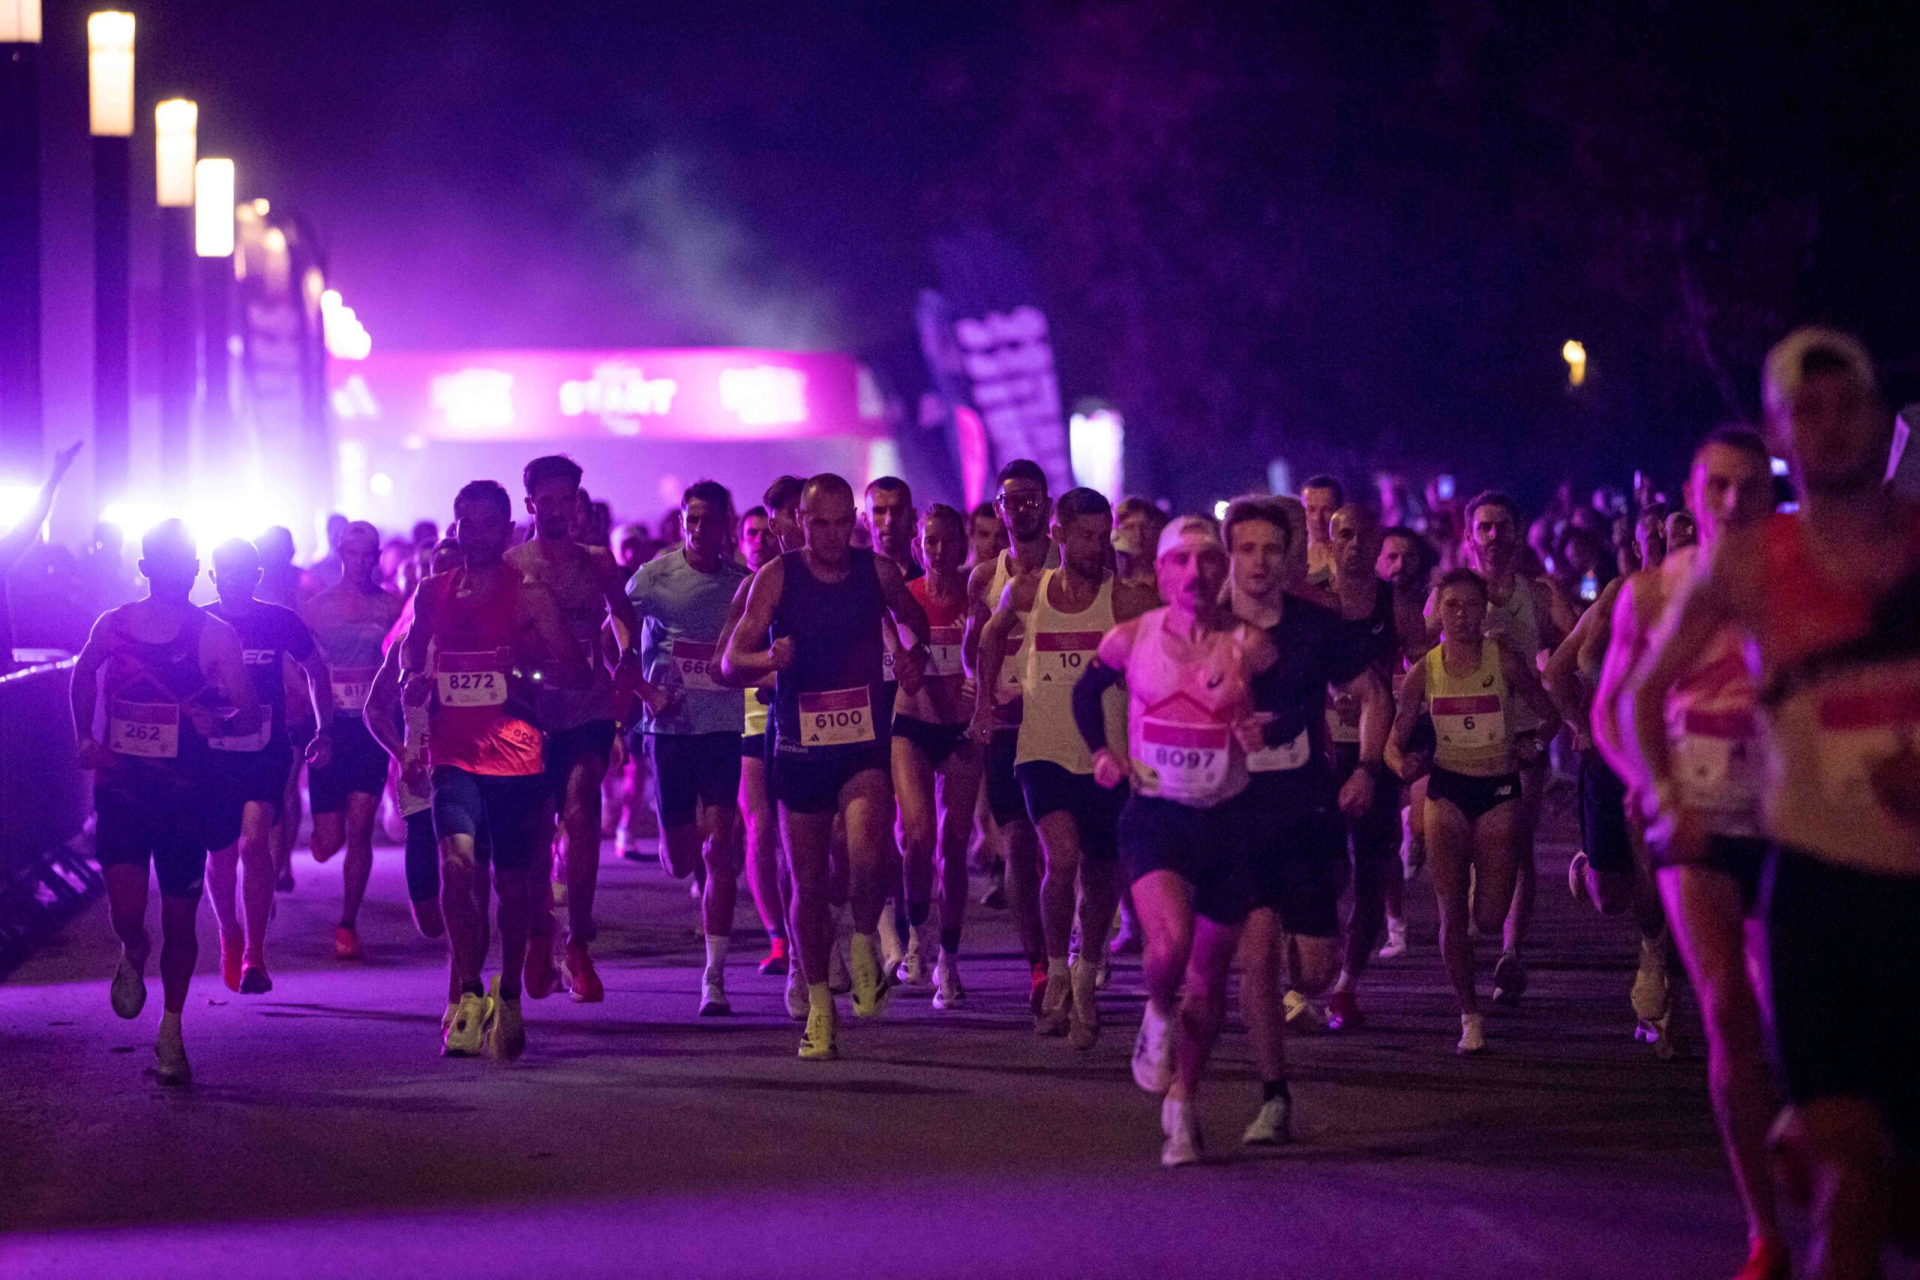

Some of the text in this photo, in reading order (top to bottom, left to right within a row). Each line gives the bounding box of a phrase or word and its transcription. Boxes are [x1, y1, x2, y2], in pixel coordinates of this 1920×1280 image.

[1060, 653, 1081, 668] 10
[449, 674, 494, 690] 8272
[815, 710, 862, 728] 6100
[1463, 716, 1475, 730] 6
[125, 723, 160, 741] 262
[1156, 748, 1216, 769] 8097
